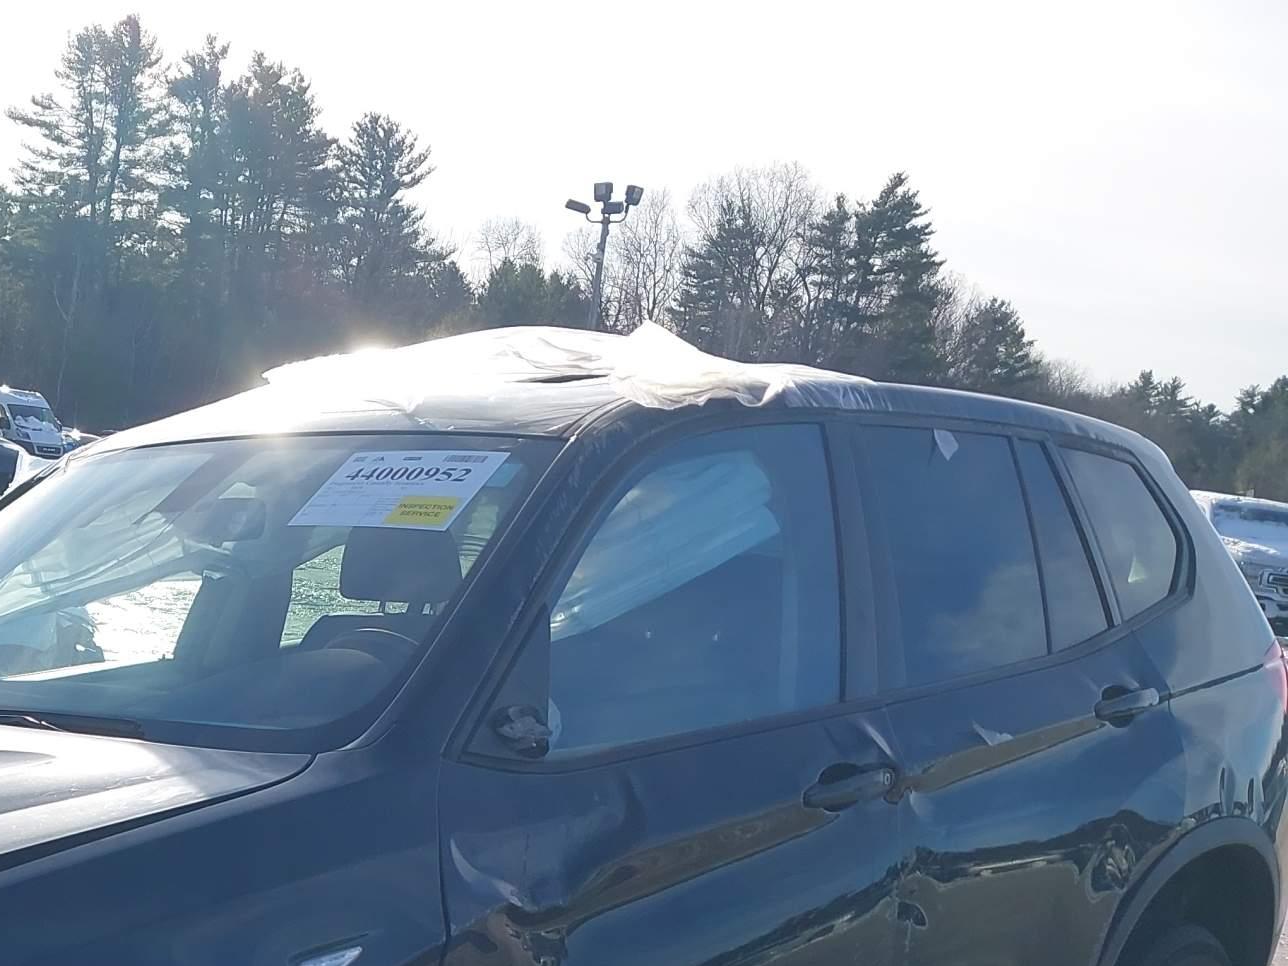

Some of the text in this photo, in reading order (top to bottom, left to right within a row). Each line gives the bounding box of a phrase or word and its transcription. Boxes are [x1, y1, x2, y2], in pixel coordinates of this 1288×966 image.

[345, 466, 473, 483] 44000952
[397, 502, 455, 511] INSPECTION
[399, 510, 441, 518] SERVICE
